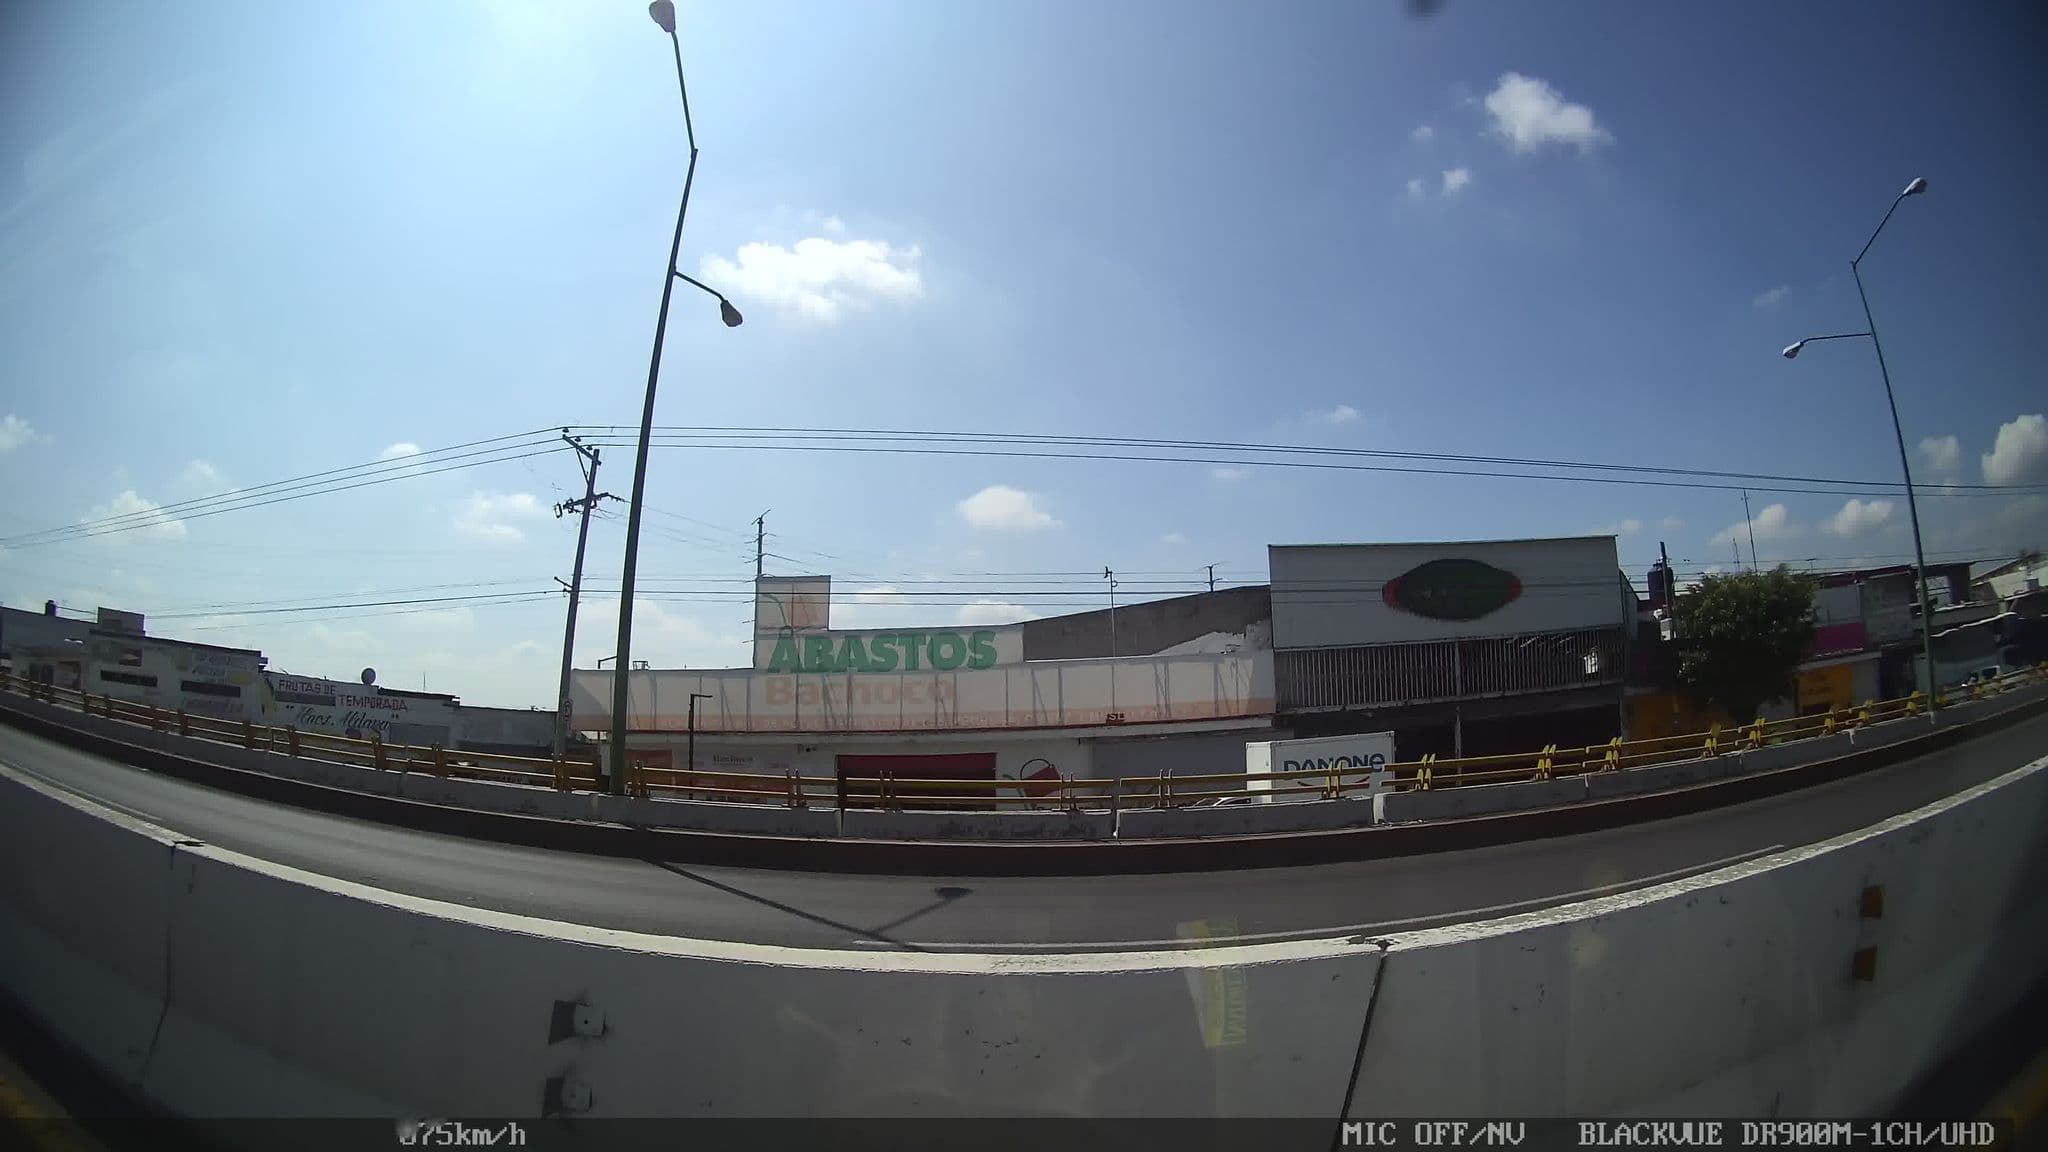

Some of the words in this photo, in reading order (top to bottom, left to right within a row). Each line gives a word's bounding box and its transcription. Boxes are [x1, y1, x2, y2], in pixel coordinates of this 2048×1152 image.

[767, 630, 997, 674] ABASTOS
[278, 679, 321, 694] FRUTAS
[322, 684, 337, 697] DE
[766, 676, 955, 706] Bachoco
[338, 694, 409, 712] TEMPORADA
